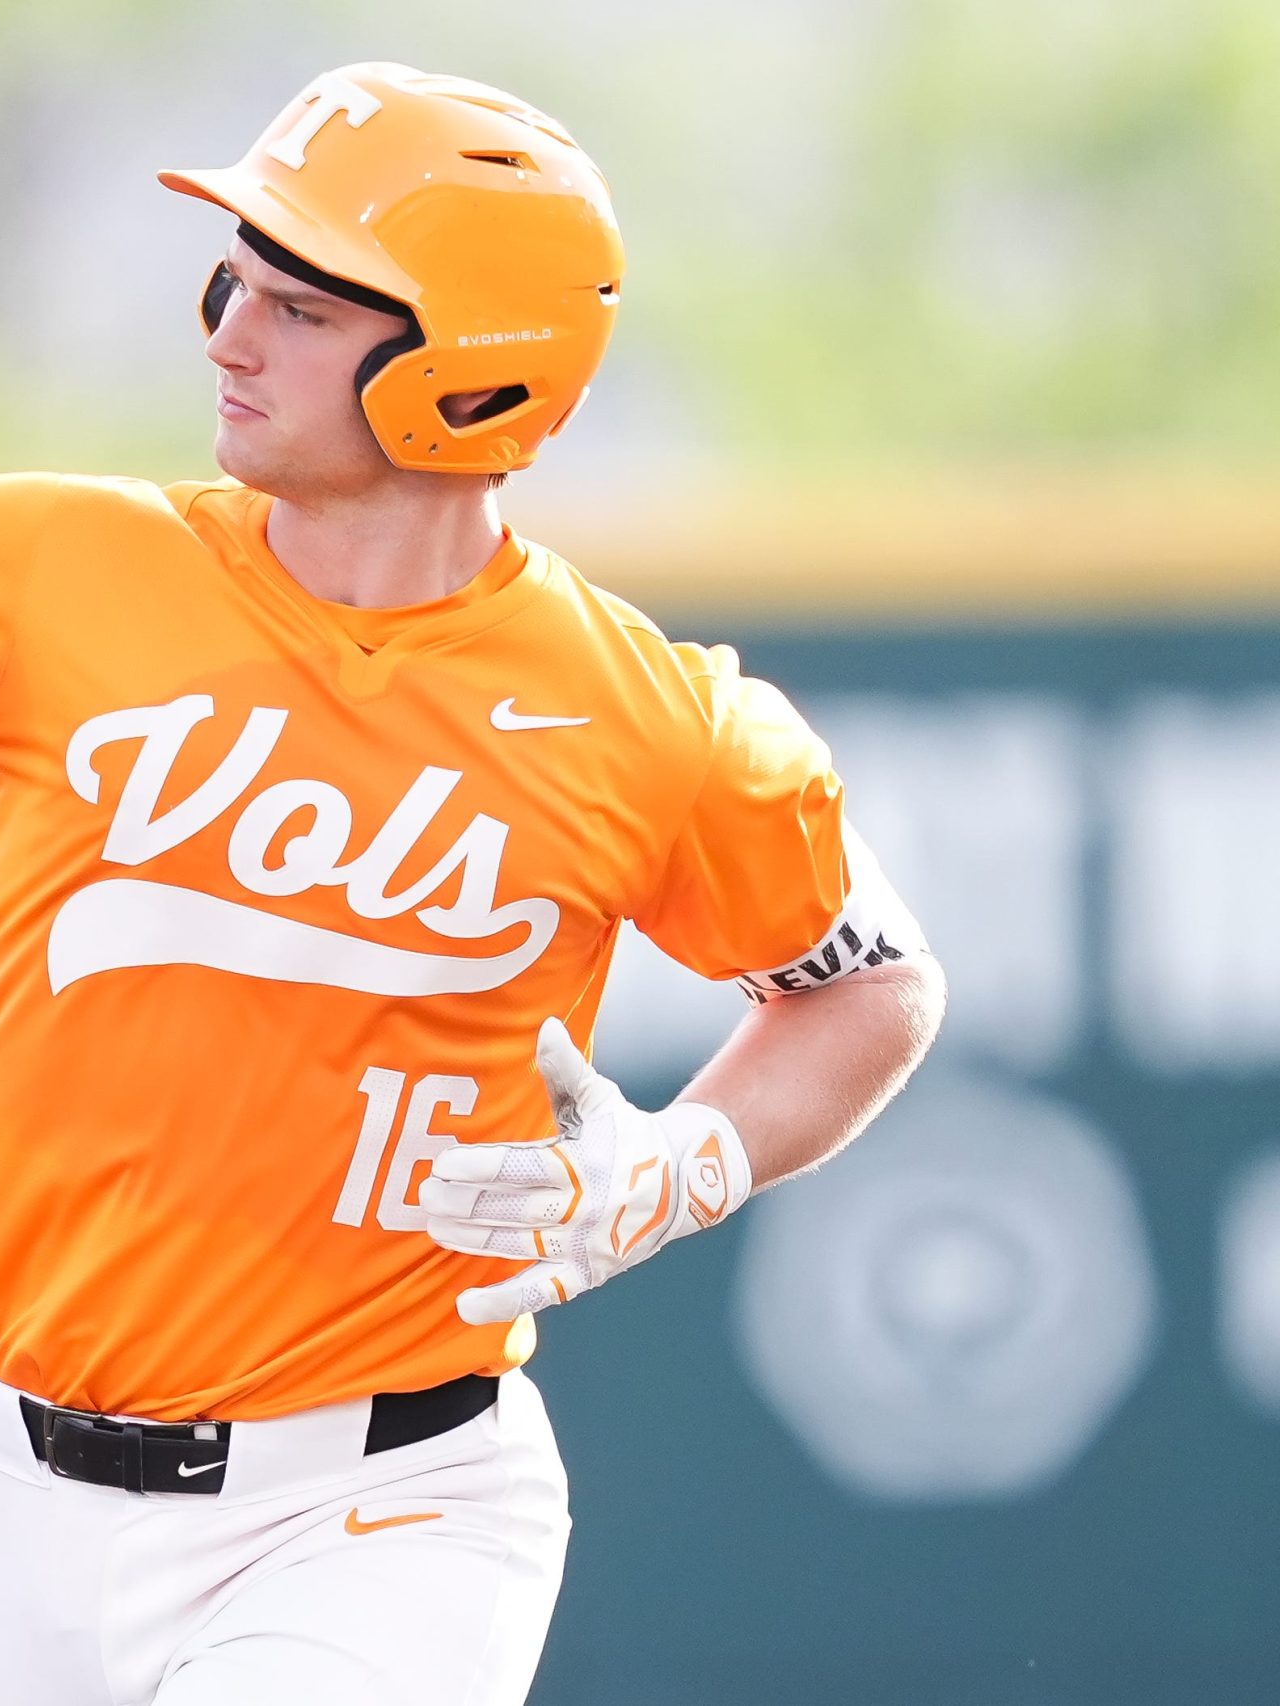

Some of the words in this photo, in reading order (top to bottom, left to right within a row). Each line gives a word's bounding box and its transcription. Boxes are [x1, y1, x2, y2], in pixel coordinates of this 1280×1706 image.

[267, 72, 383, 171] T
[457, 327, 553, 347] EVOSHIELD
[64, 693, 548, 940] Vols
[331, 1065, 480, 1232] 16
